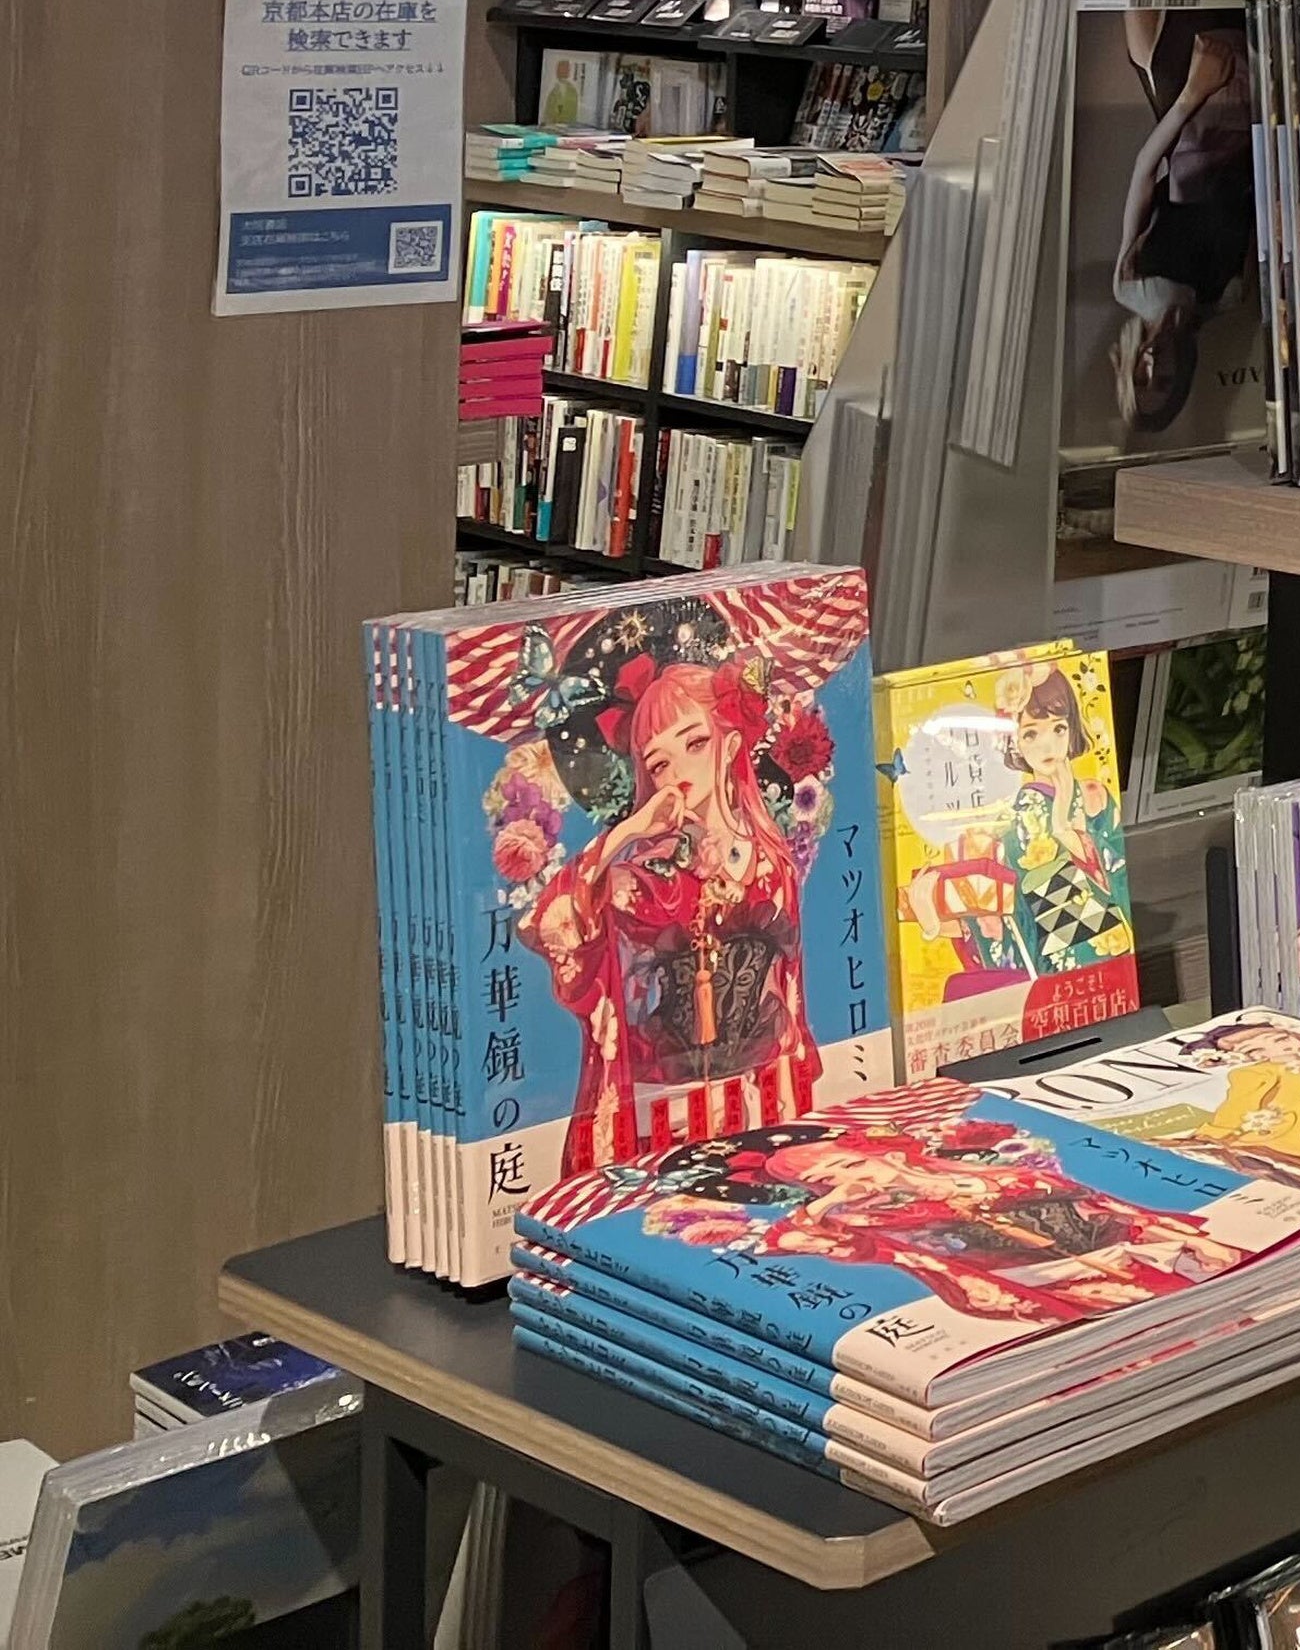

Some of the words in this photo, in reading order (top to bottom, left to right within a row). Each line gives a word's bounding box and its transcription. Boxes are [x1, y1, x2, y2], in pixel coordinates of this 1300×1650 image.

[262, 0, 438, 22] 京都本店の在庫を
[287, 28, 413, 51] 検索できます
[833, 822, 871, 1084] マツオヒロミ
[1050, 971, 1105, 1005] ようこそ!
[479, 905, 533, 1205] 万華鏡の庭
[1068, 1136, 1266, 1205] マツオヒロミ
[704, 1248, 936, 1349] 万華鏡の庭
